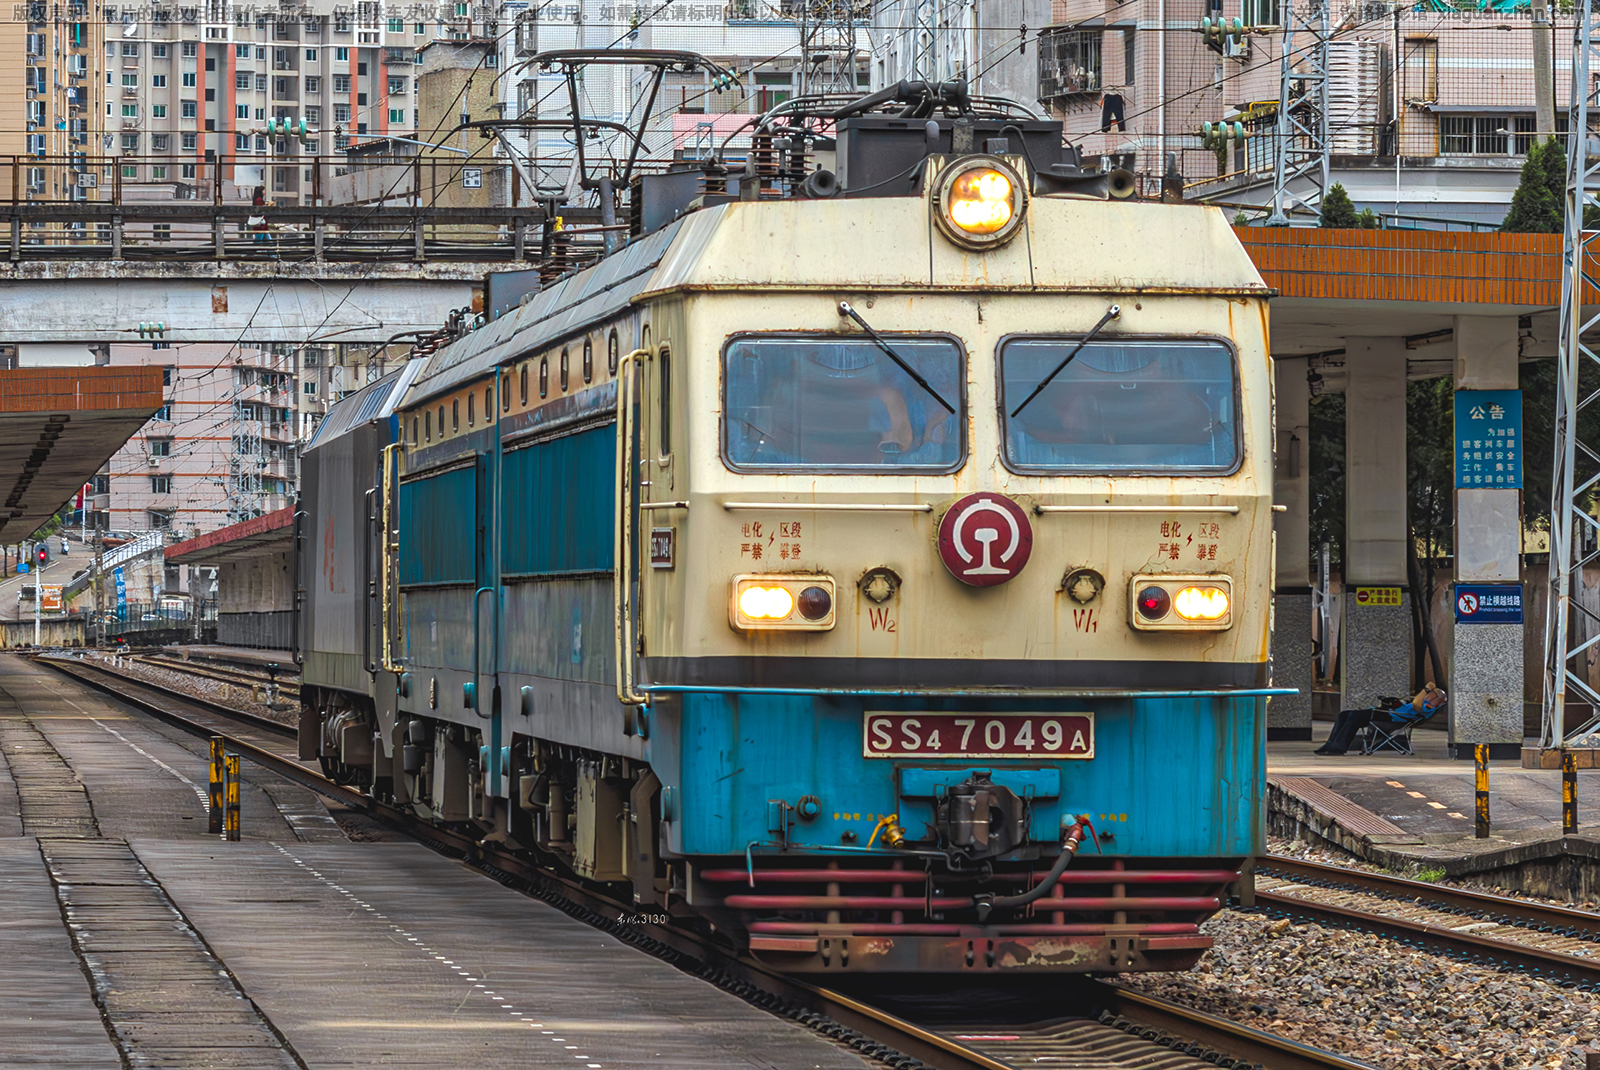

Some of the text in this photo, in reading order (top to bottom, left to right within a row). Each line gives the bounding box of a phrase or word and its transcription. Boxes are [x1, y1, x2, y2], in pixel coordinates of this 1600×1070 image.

[1469, 404, 1506, 420] 公告
[741, 521, 802, 538] 电化 区段
[1160, 520, 1220, 540] 电化 区段
[740, 543, 763, 560] 严禁
[1158, 543, 1181, 560] 严禁
[1479, 595, 1521, 606] 禁止横越线路
